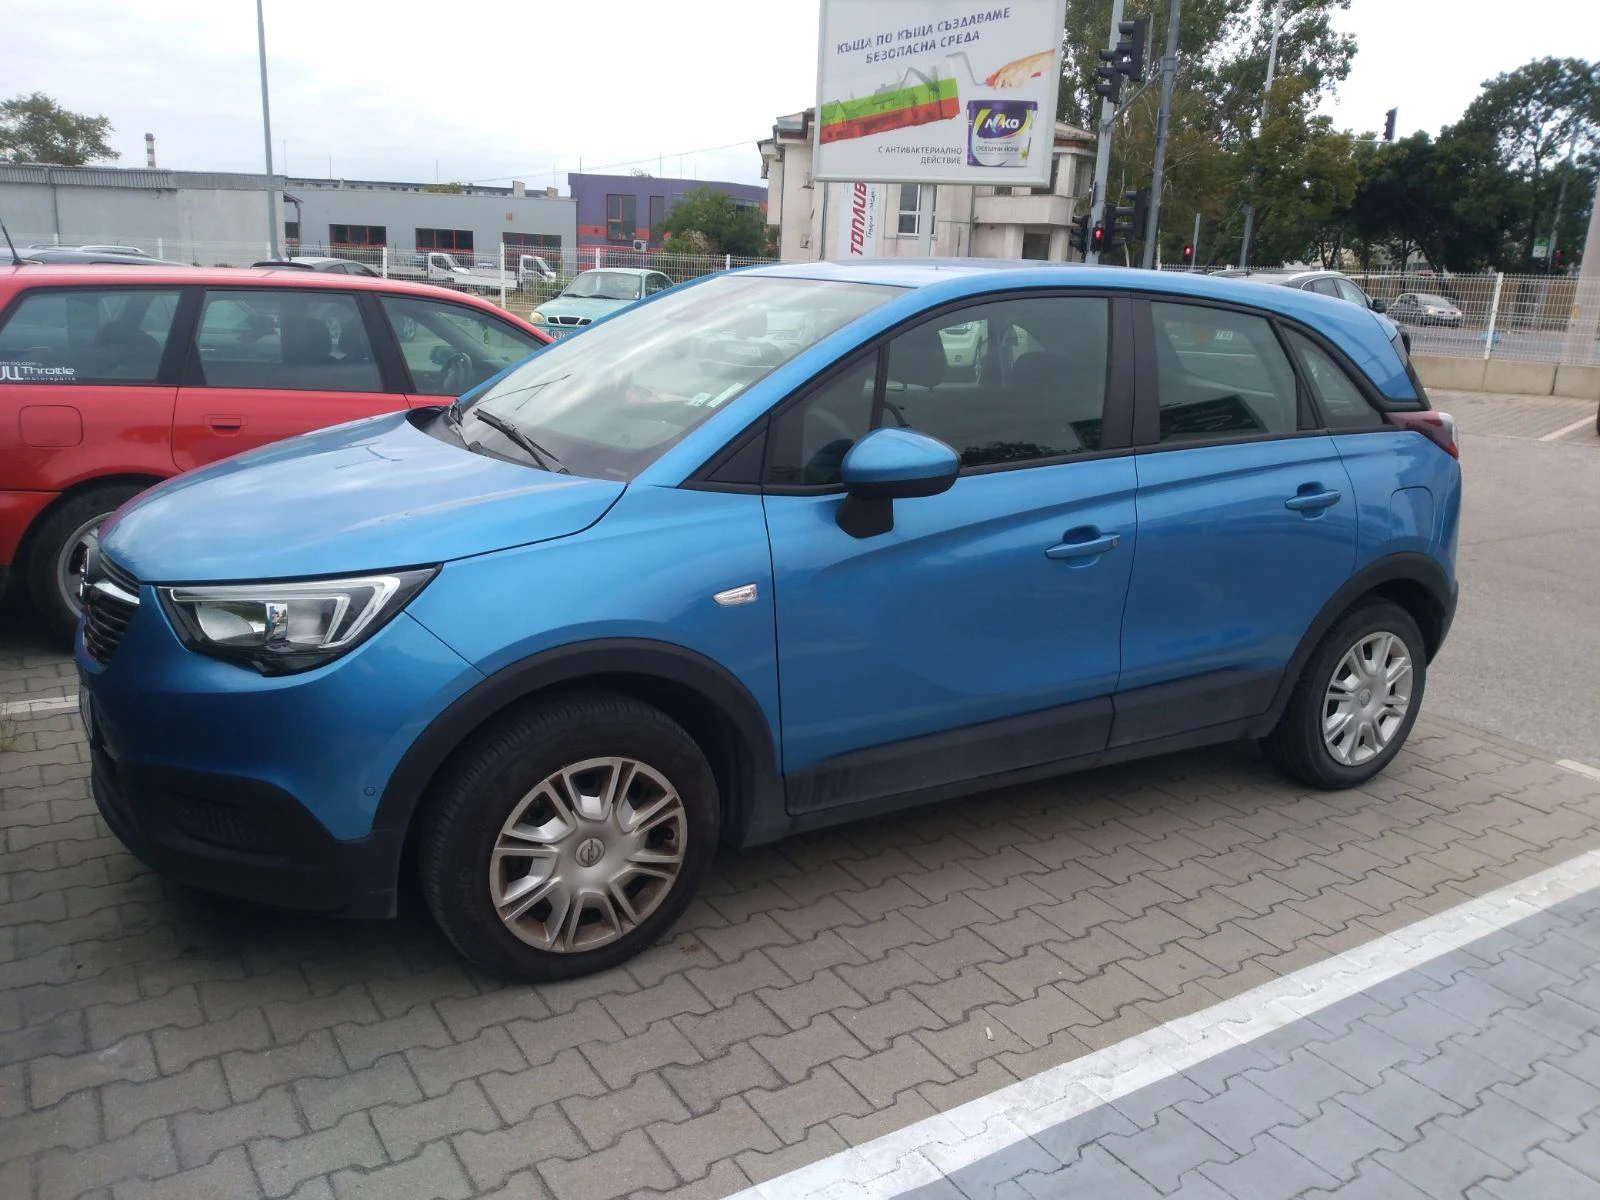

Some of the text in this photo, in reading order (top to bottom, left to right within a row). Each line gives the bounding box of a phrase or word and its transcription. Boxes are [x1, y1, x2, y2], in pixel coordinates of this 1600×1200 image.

[837, 7, 1011, 54] КЪЩА ПО КЪЩА СЪЗДАВАМЕ
[866, 30, 980, 64] БЕЗОПАСНА СРЕДА
[885, 146, 963, 155] АНТИБАКТЕРИАЛНО
[920, 155, 961, 164] ДЕЙСТВИЕ
[20, 366, 75, 375] Throttle
